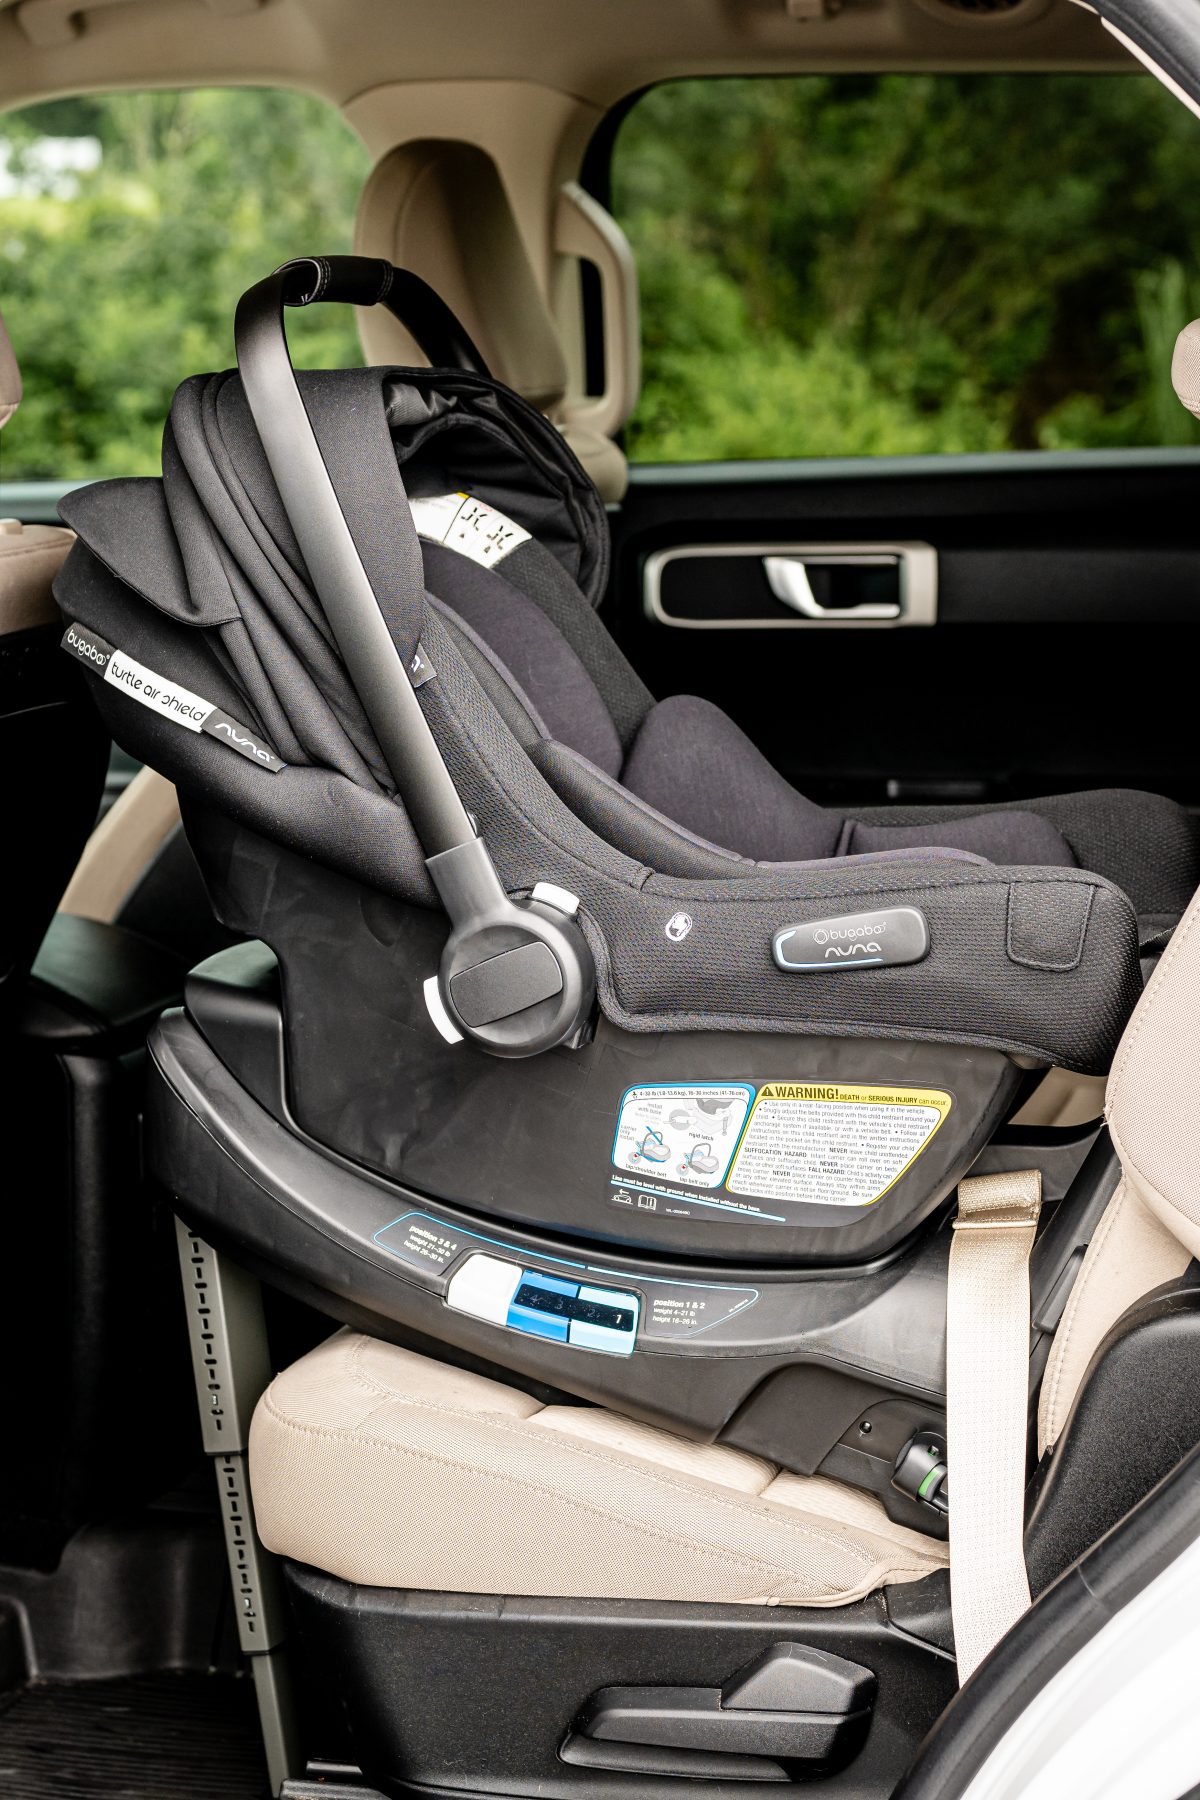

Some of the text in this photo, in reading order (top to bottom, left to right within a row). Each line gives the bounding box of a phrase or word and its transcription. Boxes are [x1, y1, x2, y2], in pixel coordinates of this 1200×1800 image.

[67, 629, 107, 666] bugaboo
[111, 661, 206, 721] turtle air shield
[215, 722, 270, 762] nuna
[830, 923, 886, 941] bugaboo
[824, 942, 882, 958] nuna
[774, 1086, 838, 1099] WARNING!
[868, 1094, 894, 1102] SERIOUS
[895, 1096, 917, 1104] INJURY
[744, 1147, 781, 1155] SUFFOCATION
[654, 1300, 684, 1308] position
